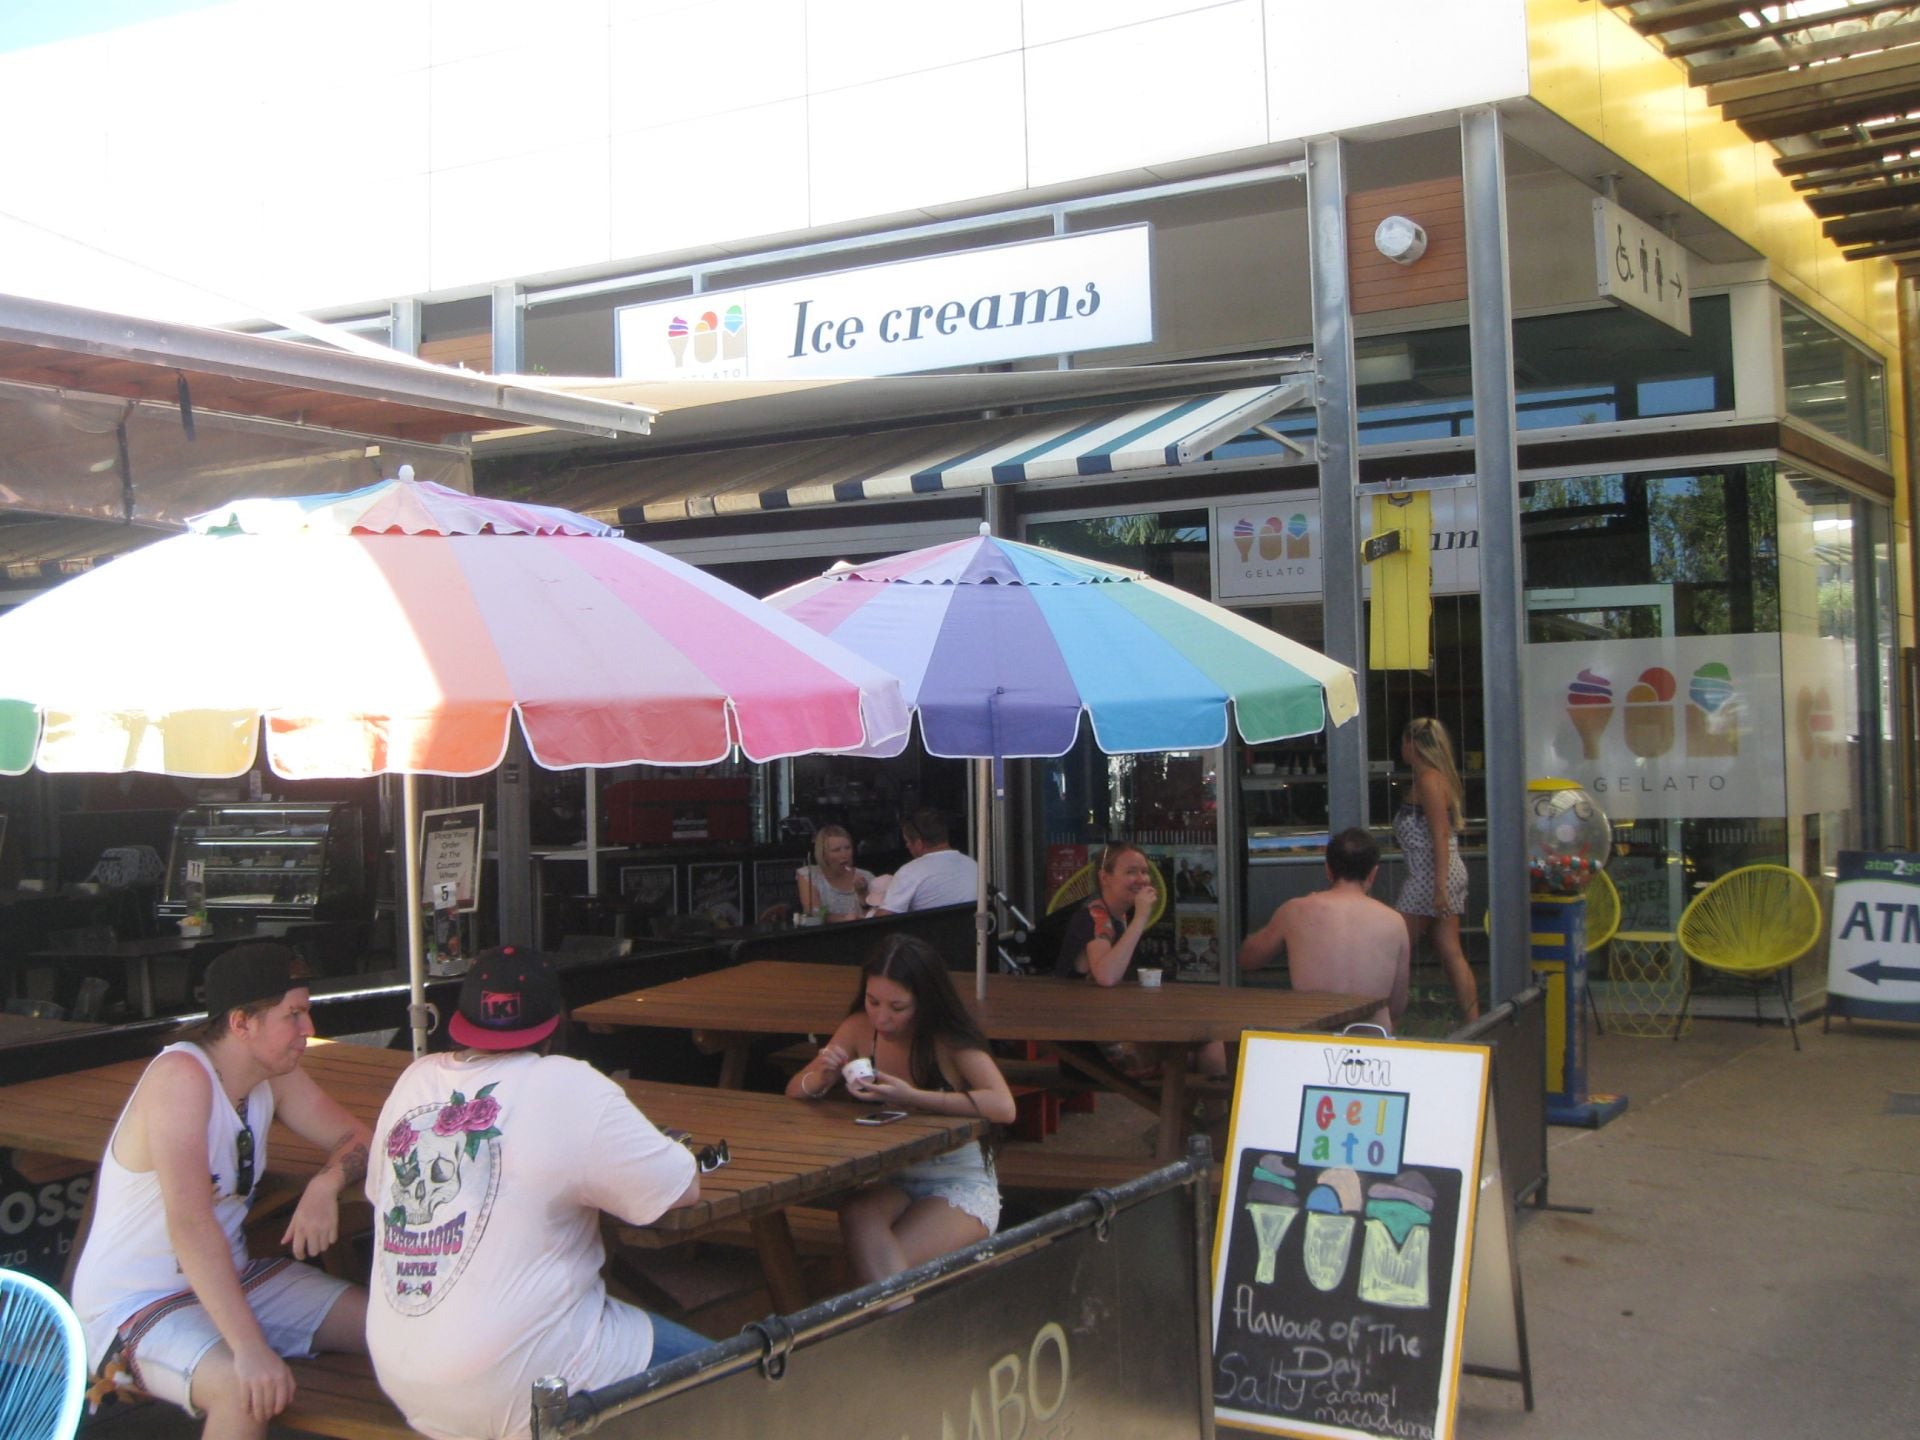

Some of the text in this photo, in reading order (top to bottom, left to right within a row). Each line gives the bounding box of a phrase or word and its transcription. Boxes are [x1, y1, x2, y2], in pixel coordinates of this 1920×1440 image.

[787, 281, 1101, 359] Ice creams
[1245, 566, 1305, 579] GELATO
[1593, 774, 1727, 794] GELATO
[441, 885, 449, 902] 5
[1838, 900, 1920, 944] ATM
[0, 1178, 91, 1235] OSS
[396, 1260, 438, 1277] NATURE
[902, 1321, 1070, 1440] MBO
